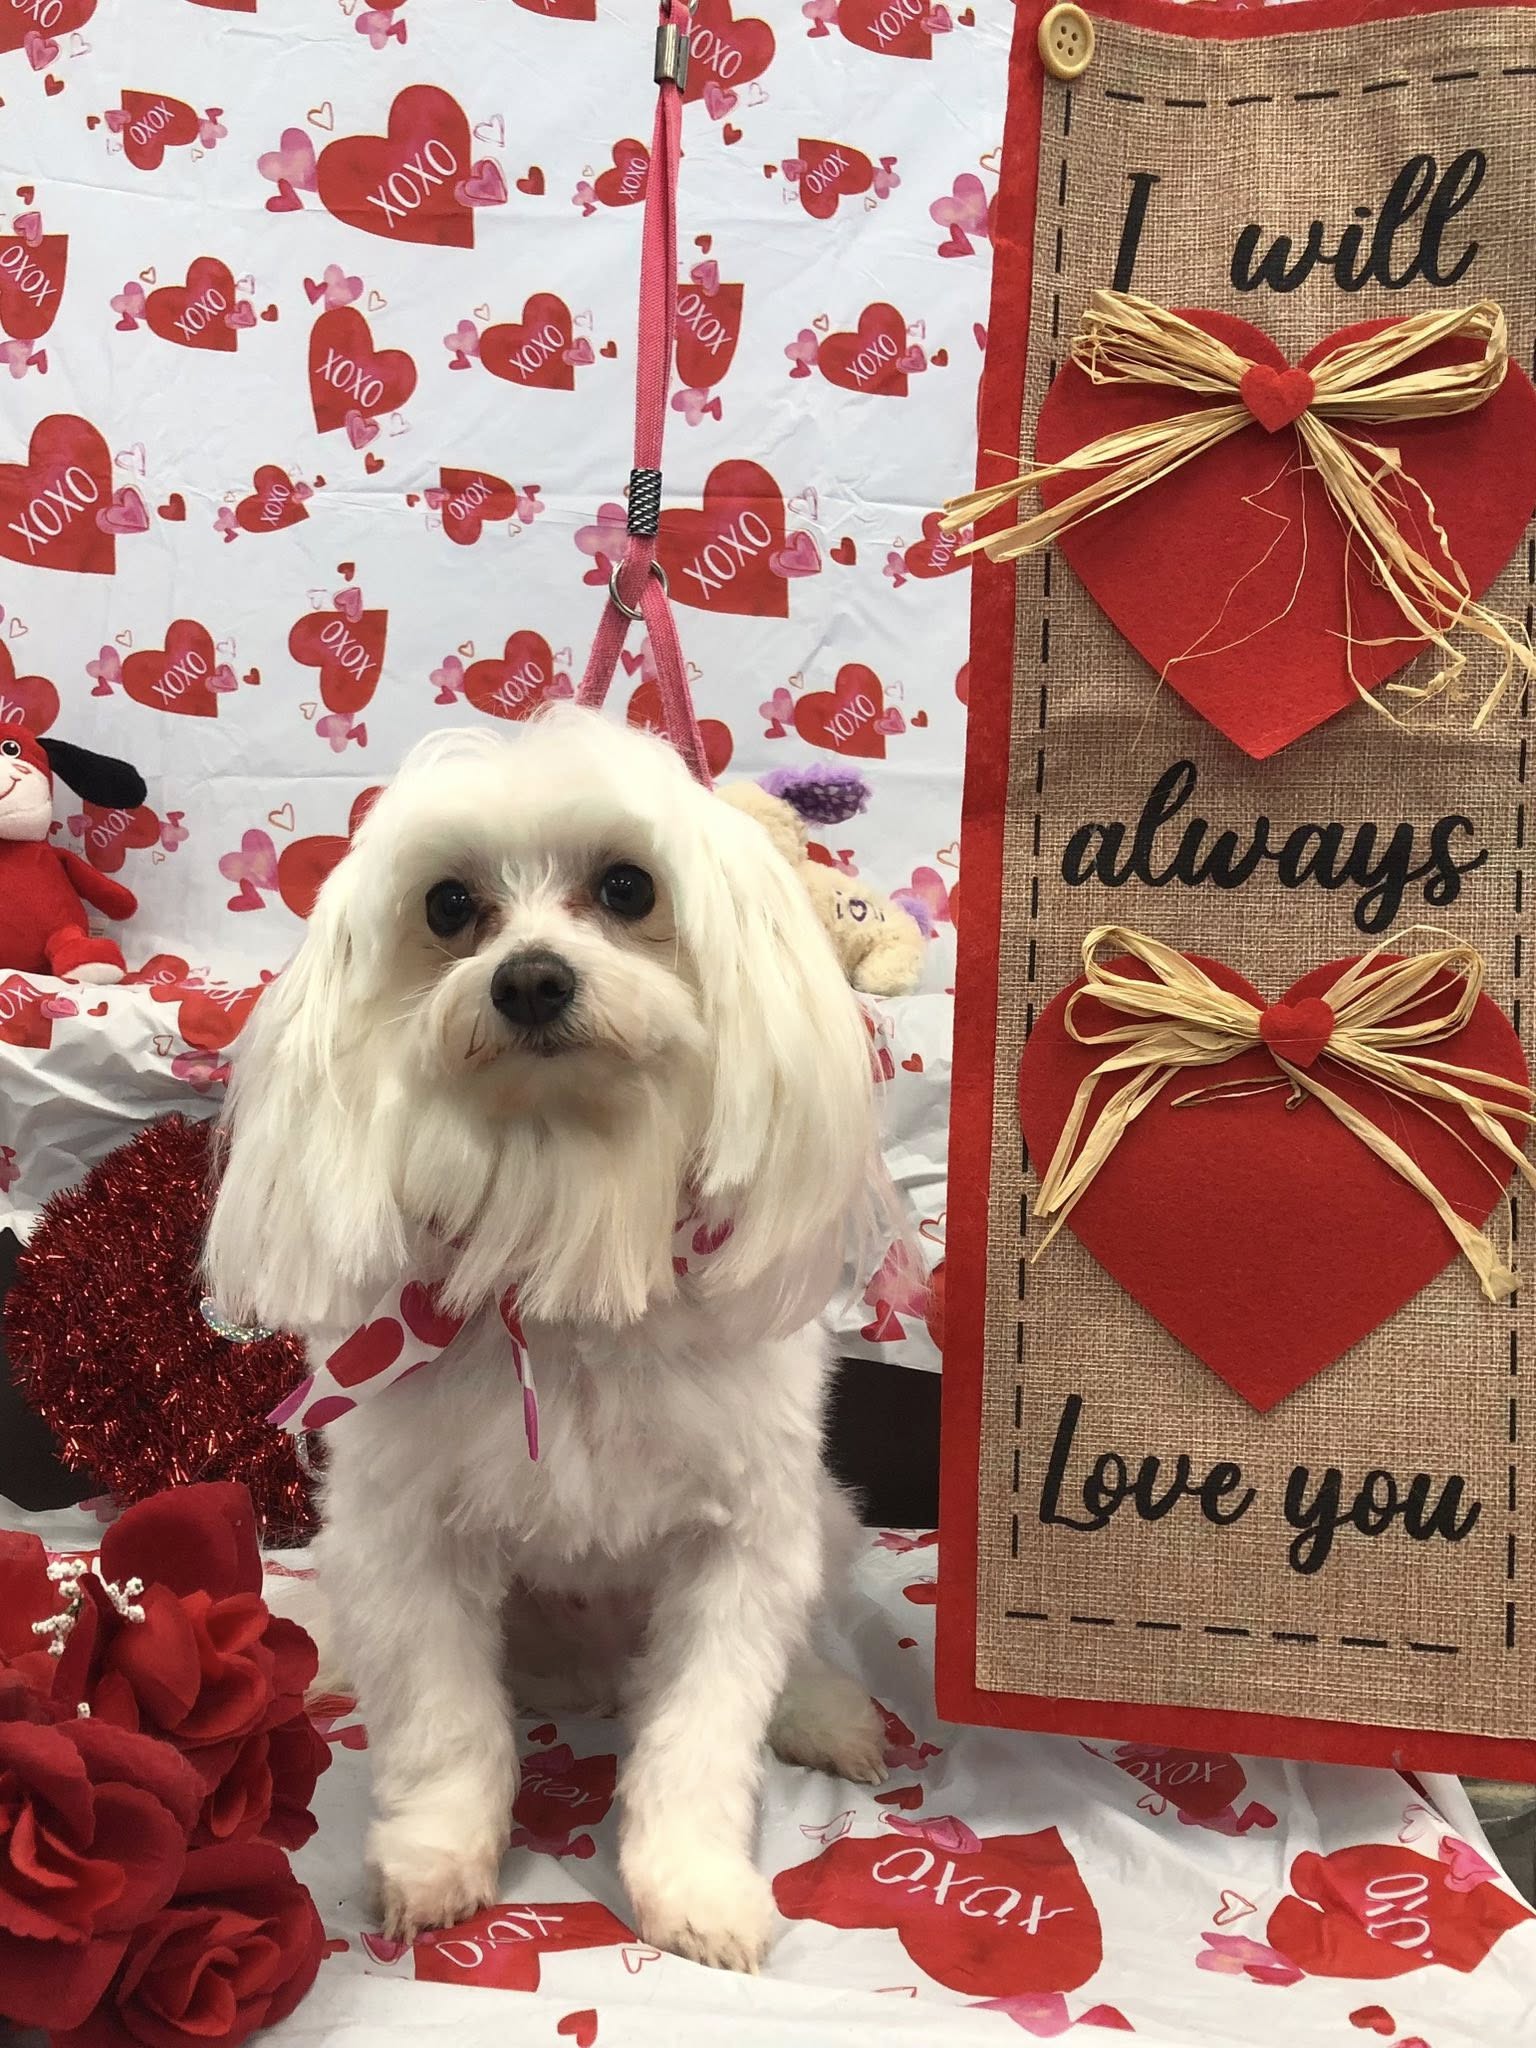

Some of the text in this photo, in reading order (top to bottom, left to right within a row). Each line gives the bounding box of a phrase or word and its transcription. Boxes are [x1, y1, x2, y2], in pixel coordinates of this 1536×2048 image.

[366, 139, 458, 229] XOXO
[618, 157, 648, 199] XOXO
[1112, 149, 1486, 292] I will
[174, 288, 228, 341] XOXO
[315, 347, 384, 408] XOXO
[509, 324, 565, 379] XOXO
[846, 333, 898, 386] XOXO
[8, 466, 100, 556] XOXO
[260, 483, 291, 526] XOXO
[682, 511, 772, 601] XOXO
[151, 650, 208, 706] XOXO
[492, 661, 545, 714] XOXO
[823, 694, 876, 747] XOXO
[1061, 759, 1489, 934] always
[1040, 1394, 1482, 1575] Love you
